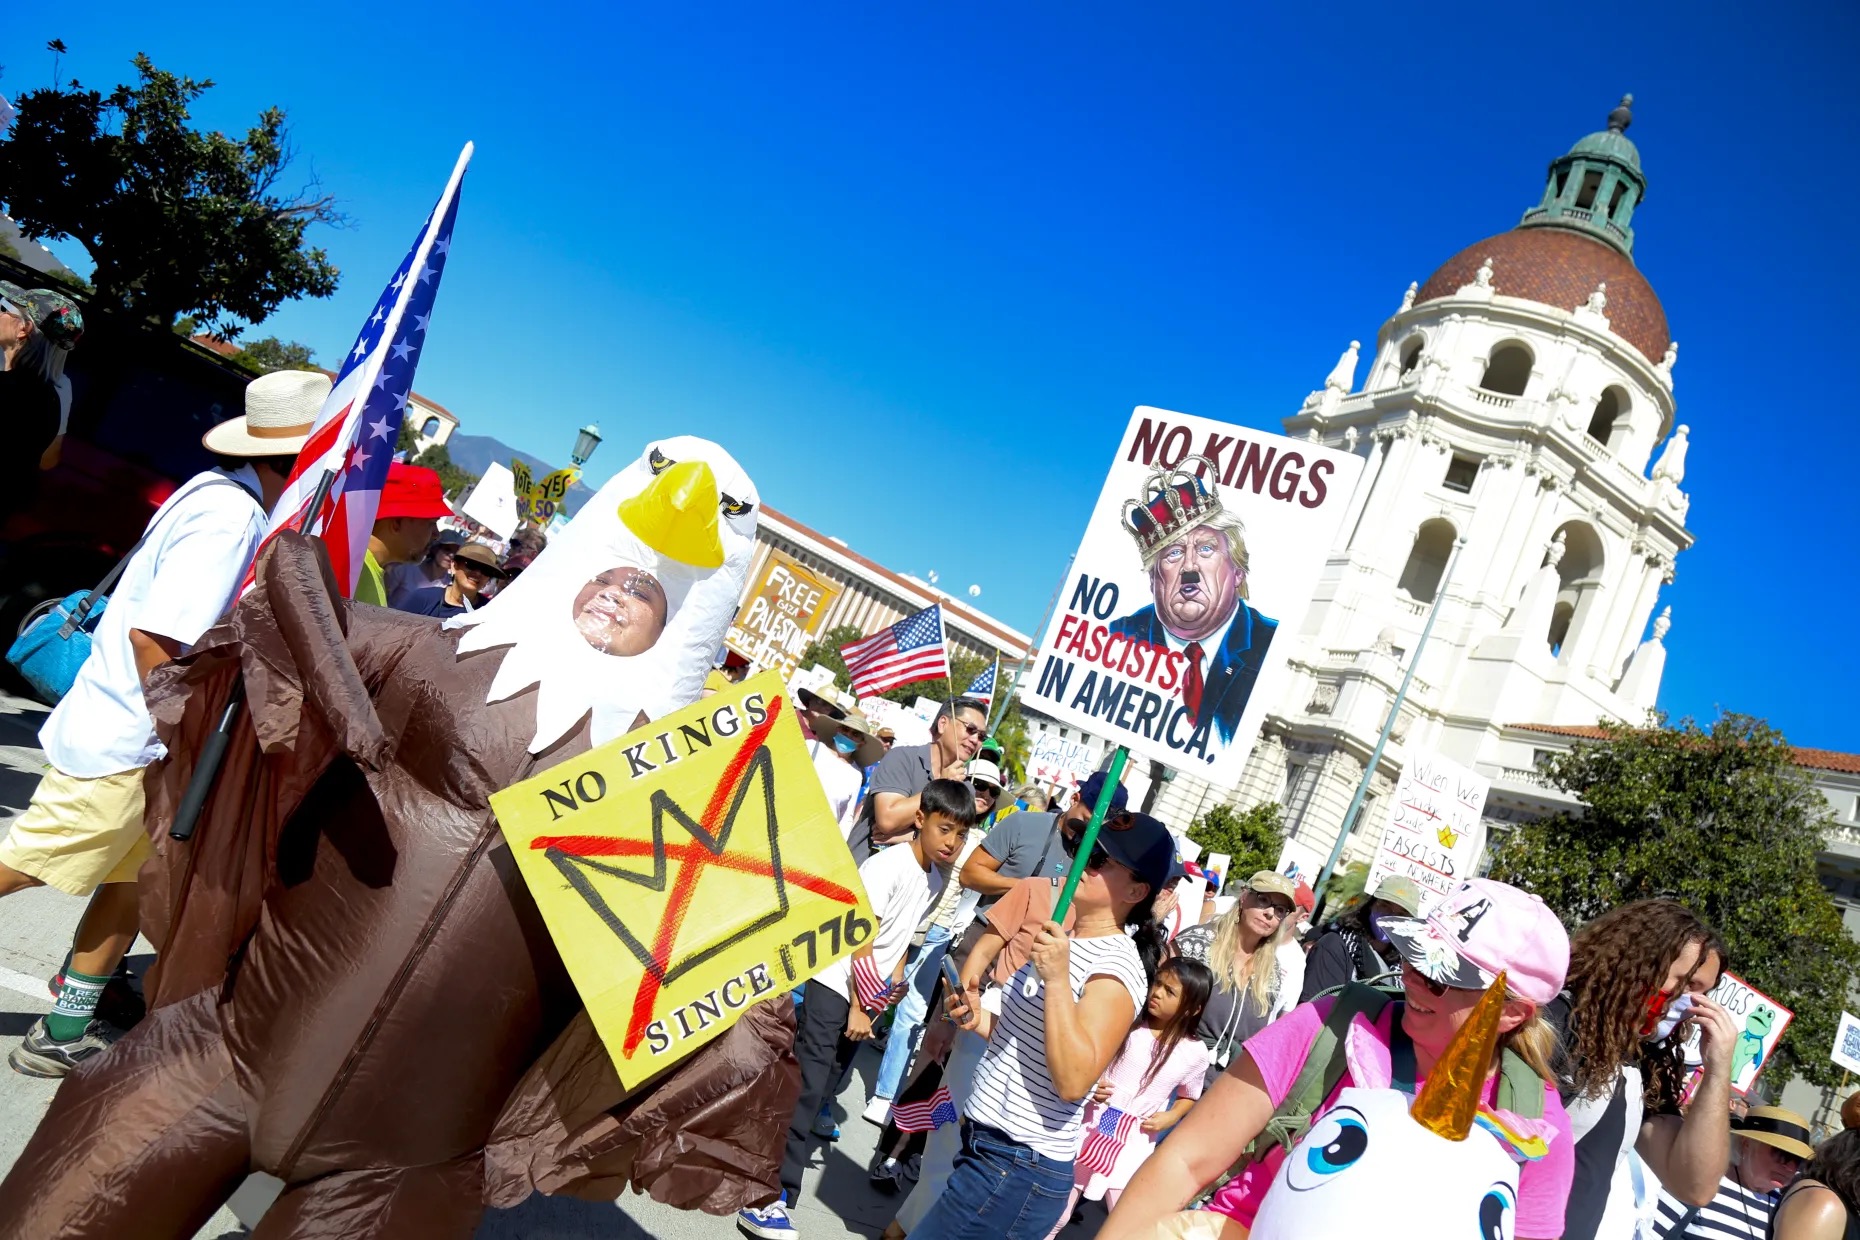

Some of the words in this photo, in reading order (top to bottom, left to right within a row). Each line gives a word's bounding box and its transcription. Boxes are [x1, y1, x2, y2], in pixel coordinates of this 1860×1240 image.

[512, 466, 532, 494] VOTE
[541, 474, 571, 498] YES
[1127, 418, 1192, 470] NO
[1195, 433, 1335, 508] KINGS
[535, 500, 554, 518] 50
[766, 566, 820, 614] FREE
[776, 599, 799, 617] GAZA
[1069, 573, 1120, 621] NO
[744, 597, 814, 660] PALESTINE
[1036, 655, 1075, 703] IN
[1054, 614, 1184, 699] FASCISTS,
[540, 771, 607, 821] NO
[622, 694, 767, 778] KINGS
[1034, 747, 1090, 774] PATRIOTS
[1037, 733, 1092, 762] ACTUAL
[1413, 752, 1448, 791] When
[1457, 776, 1479, 806] We
[1383, 829, 1454, 876] FASCISTS
[1456, 898, 1492, 943] A
[59, 1000, 96, 1011] BOOK
[75, 989, 101, 998] REA
[646, 963, 774, 1055] SINCE
[778, 909, 873, 982] 1776
[1711, 976, 1754, 1015] ROGS
